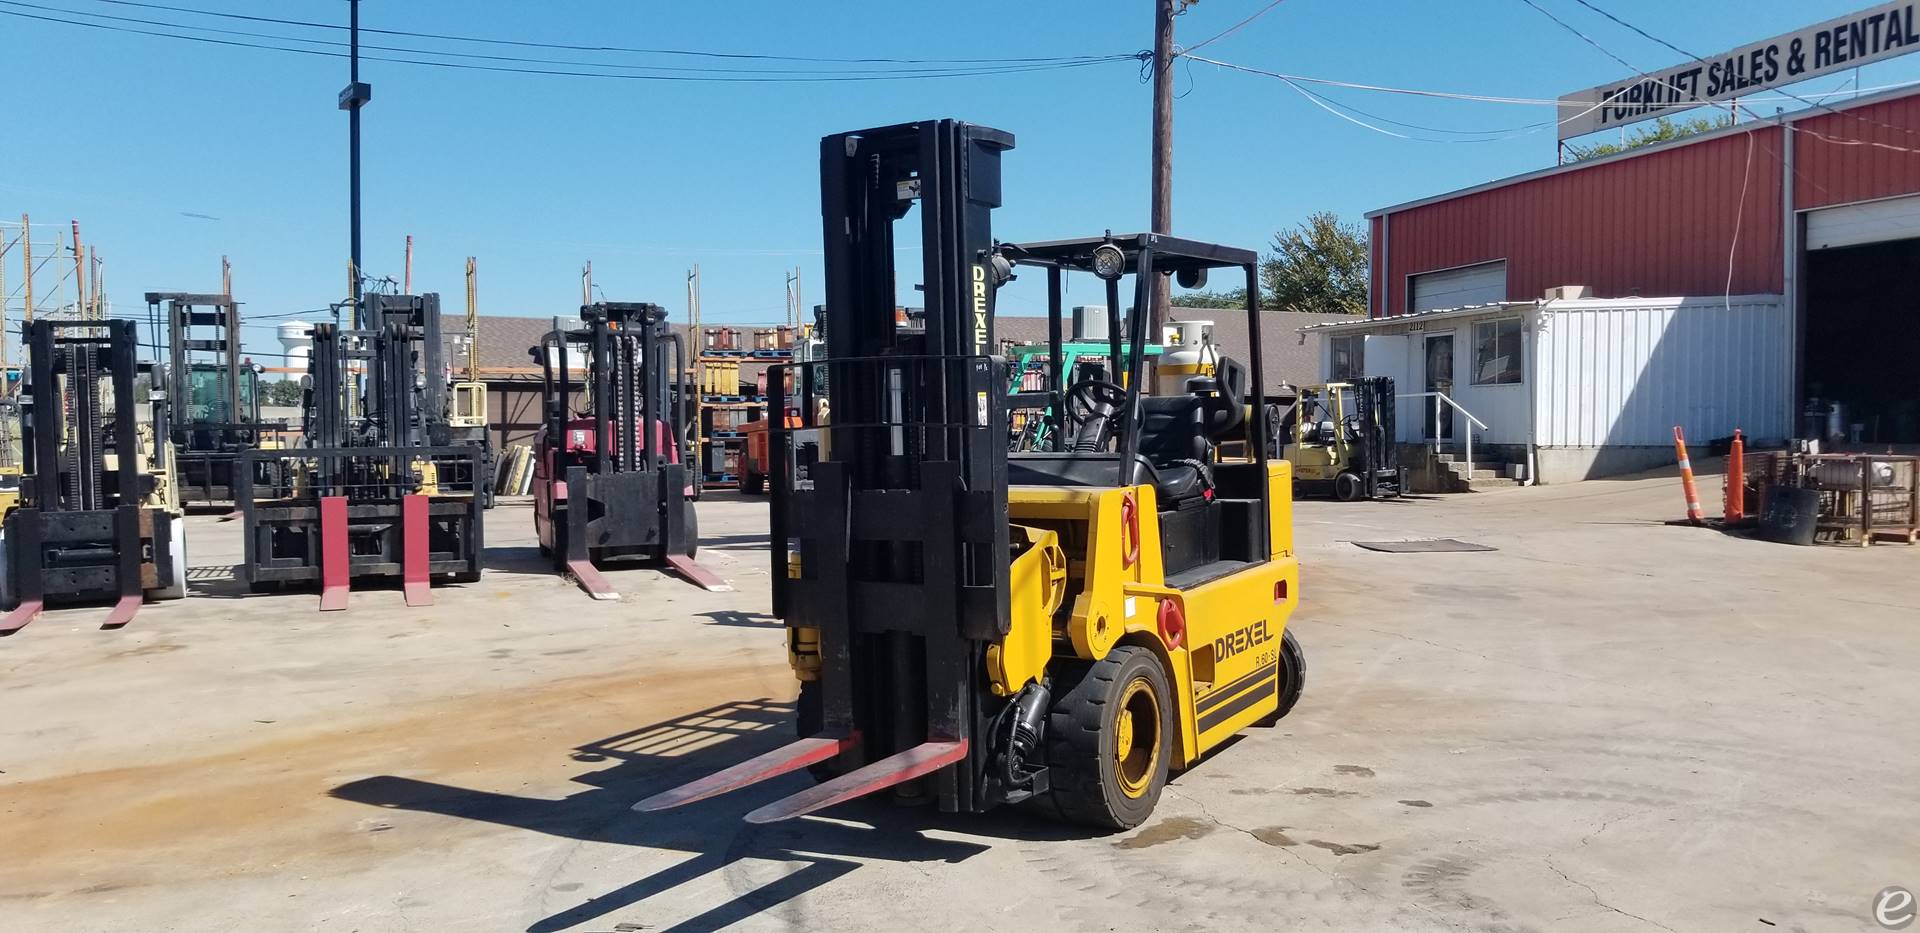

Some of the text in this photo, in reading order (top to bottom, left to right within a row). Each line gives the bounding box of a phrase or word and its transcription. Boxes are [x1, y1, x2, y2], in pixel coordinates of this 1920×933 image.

[1602, 5, 1920, 123] FORKLIFT SALES & RENTAL
[972, 265, 987, 359] DREXEL
[1215, 619, 1274, 663] DREXEL
